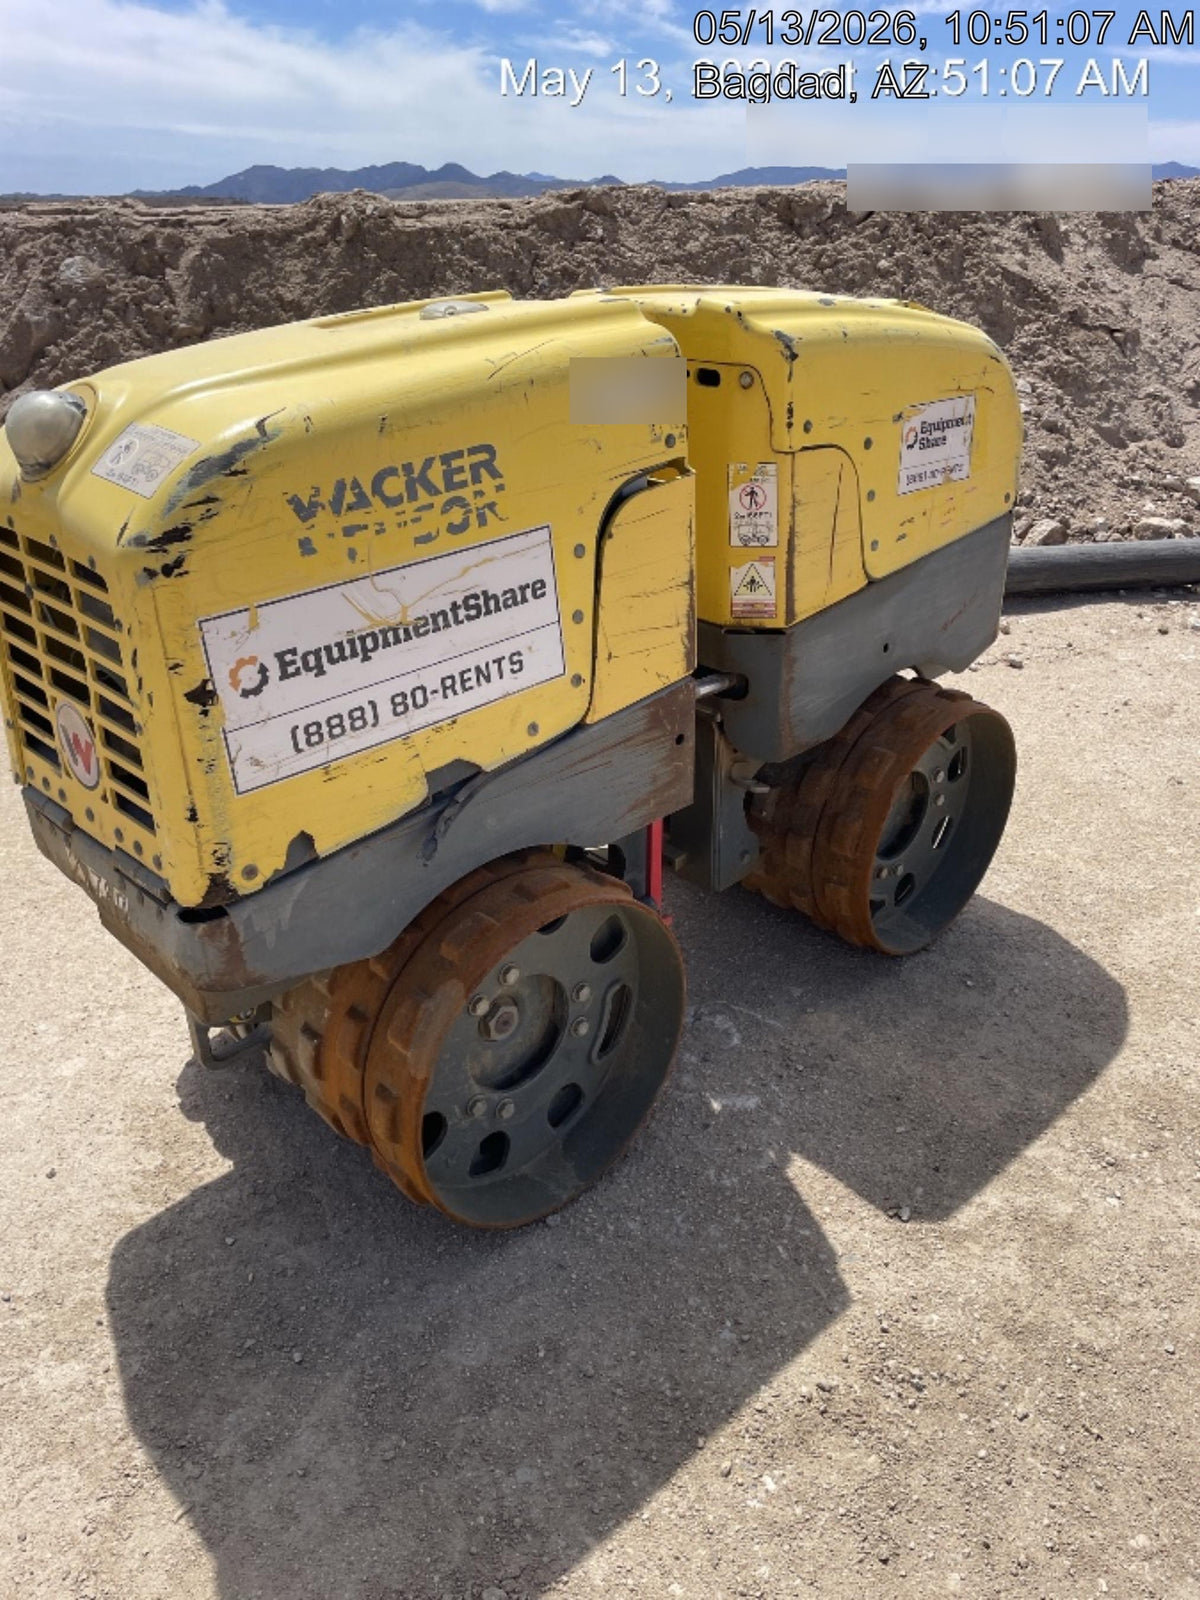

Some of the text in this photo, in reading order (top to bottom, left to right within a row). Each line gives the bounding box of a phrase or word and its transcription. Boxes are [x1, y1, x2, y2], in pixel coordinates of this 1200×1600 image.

[287, 443, 504, 523] WACKER
[273, 578, 547, 682] EquipmentShare
[290, 650, 525, 753] (888) 80-RENTS
